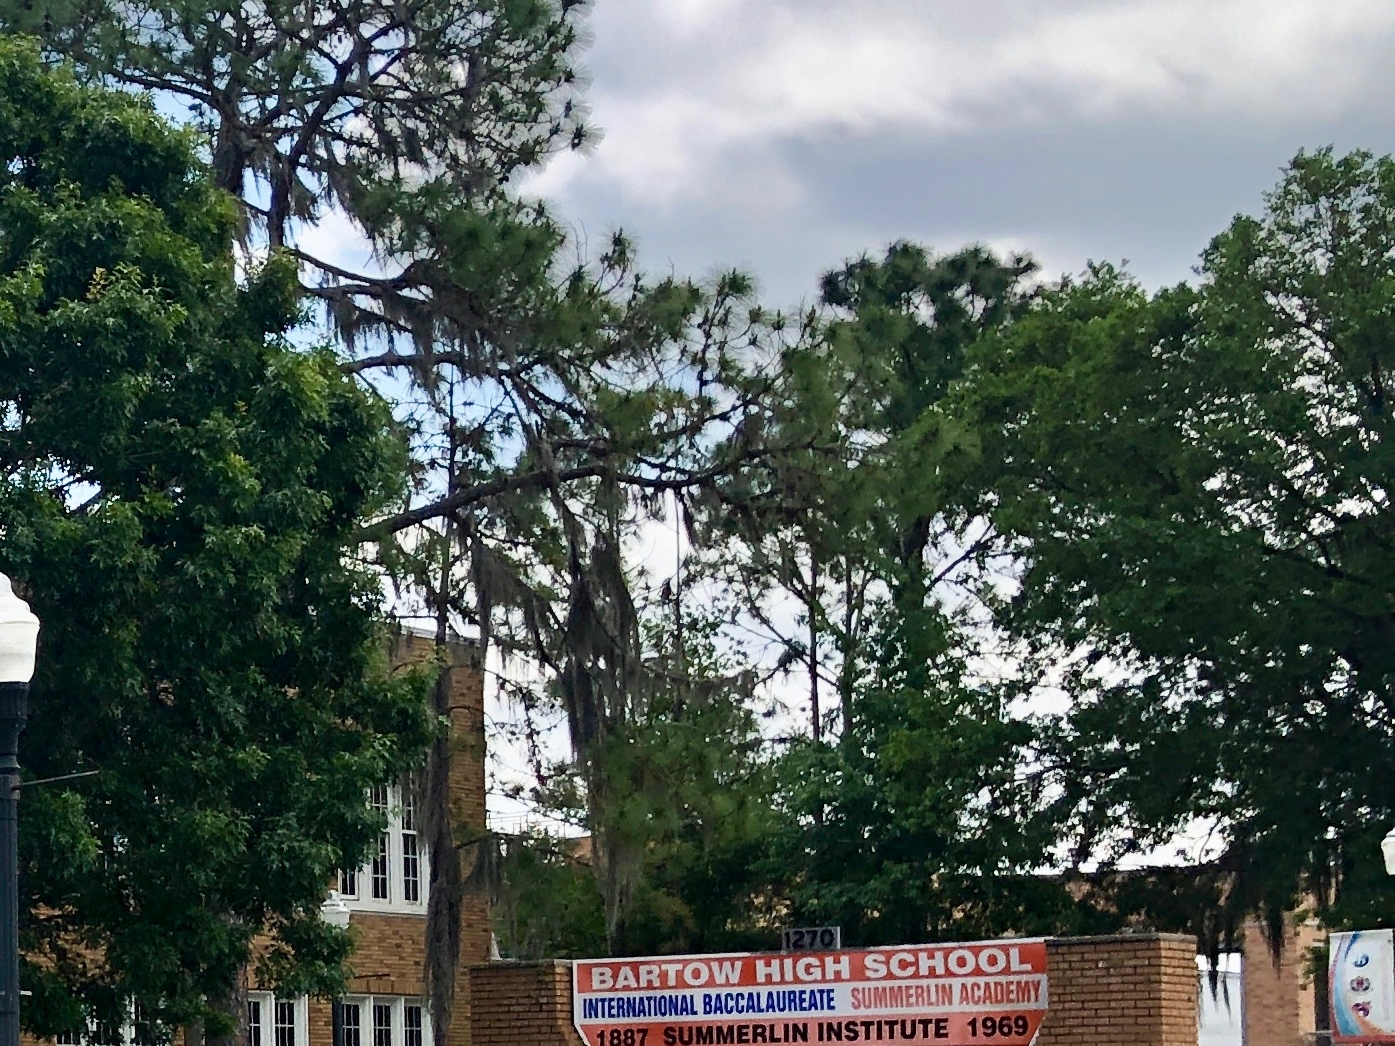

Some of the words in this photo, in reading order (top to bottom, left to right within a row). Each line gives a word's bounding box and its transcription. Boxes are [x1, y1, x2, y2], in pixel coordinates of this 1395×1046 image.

[784, 928, 834, 948] 1270
[591, 961, 742, 990] BARTOW
[755, 956, 850, 983] HIGH
[864, 948, 1033, 979] SCHOOL
[583, 993, 698, 1018] INTERNATIONAL
[703, 988, 836, 1016] BACCALAUREATE
[850, 985, 953, 1009] SUMMERLIN
[959, 979, 1041, 1005] ACADEMY
[663, 1022, 809, 1046] SUMMERLIN
[817, 1018, 949, 1042] INSTITUTE
[967, 1015, 1029, 1038] 1969
